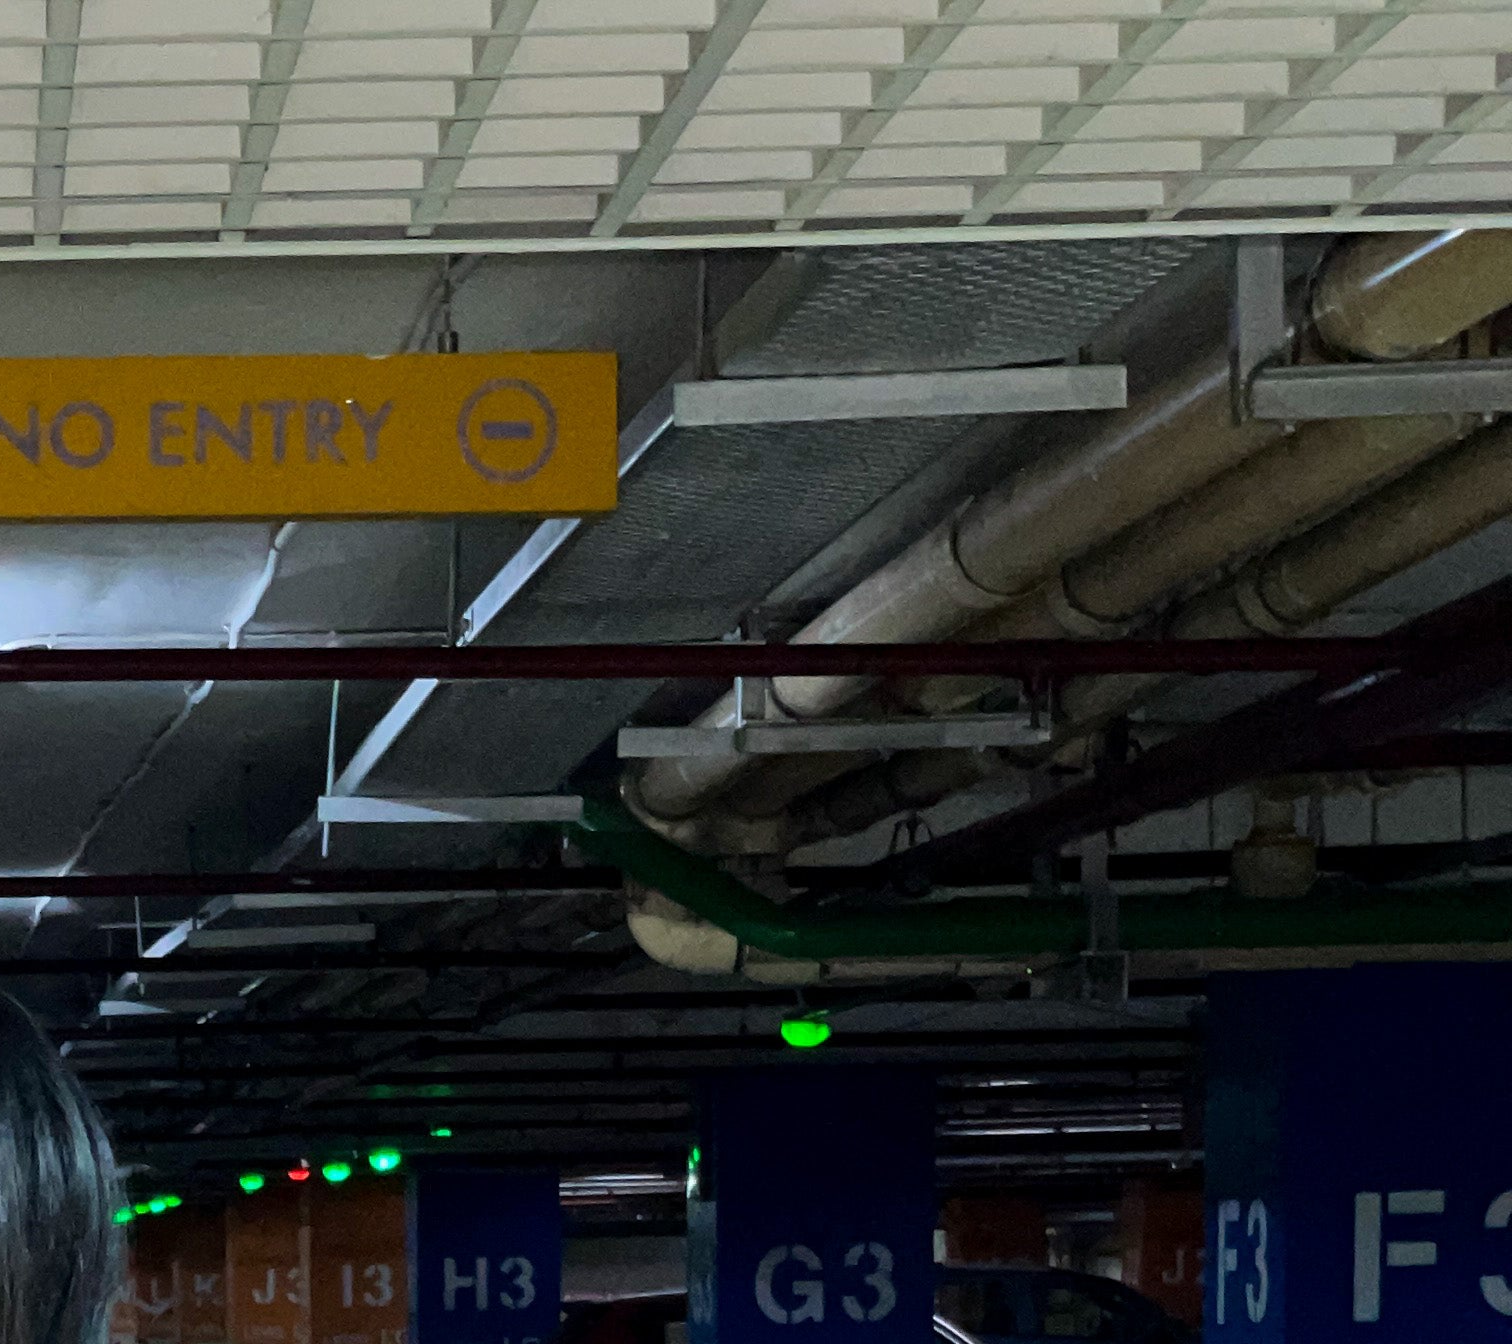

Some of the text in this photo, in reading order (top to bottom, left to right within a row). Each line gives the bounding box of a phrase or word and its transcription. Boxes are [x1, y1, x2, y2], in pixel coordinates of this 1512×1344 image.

[148, 397, 393, 468] ENTRY
[443, 1255, 537, 1312] H3
[755, 1241, 897, 1325] G3
[1216, 1198, 1268, 1325] F3
